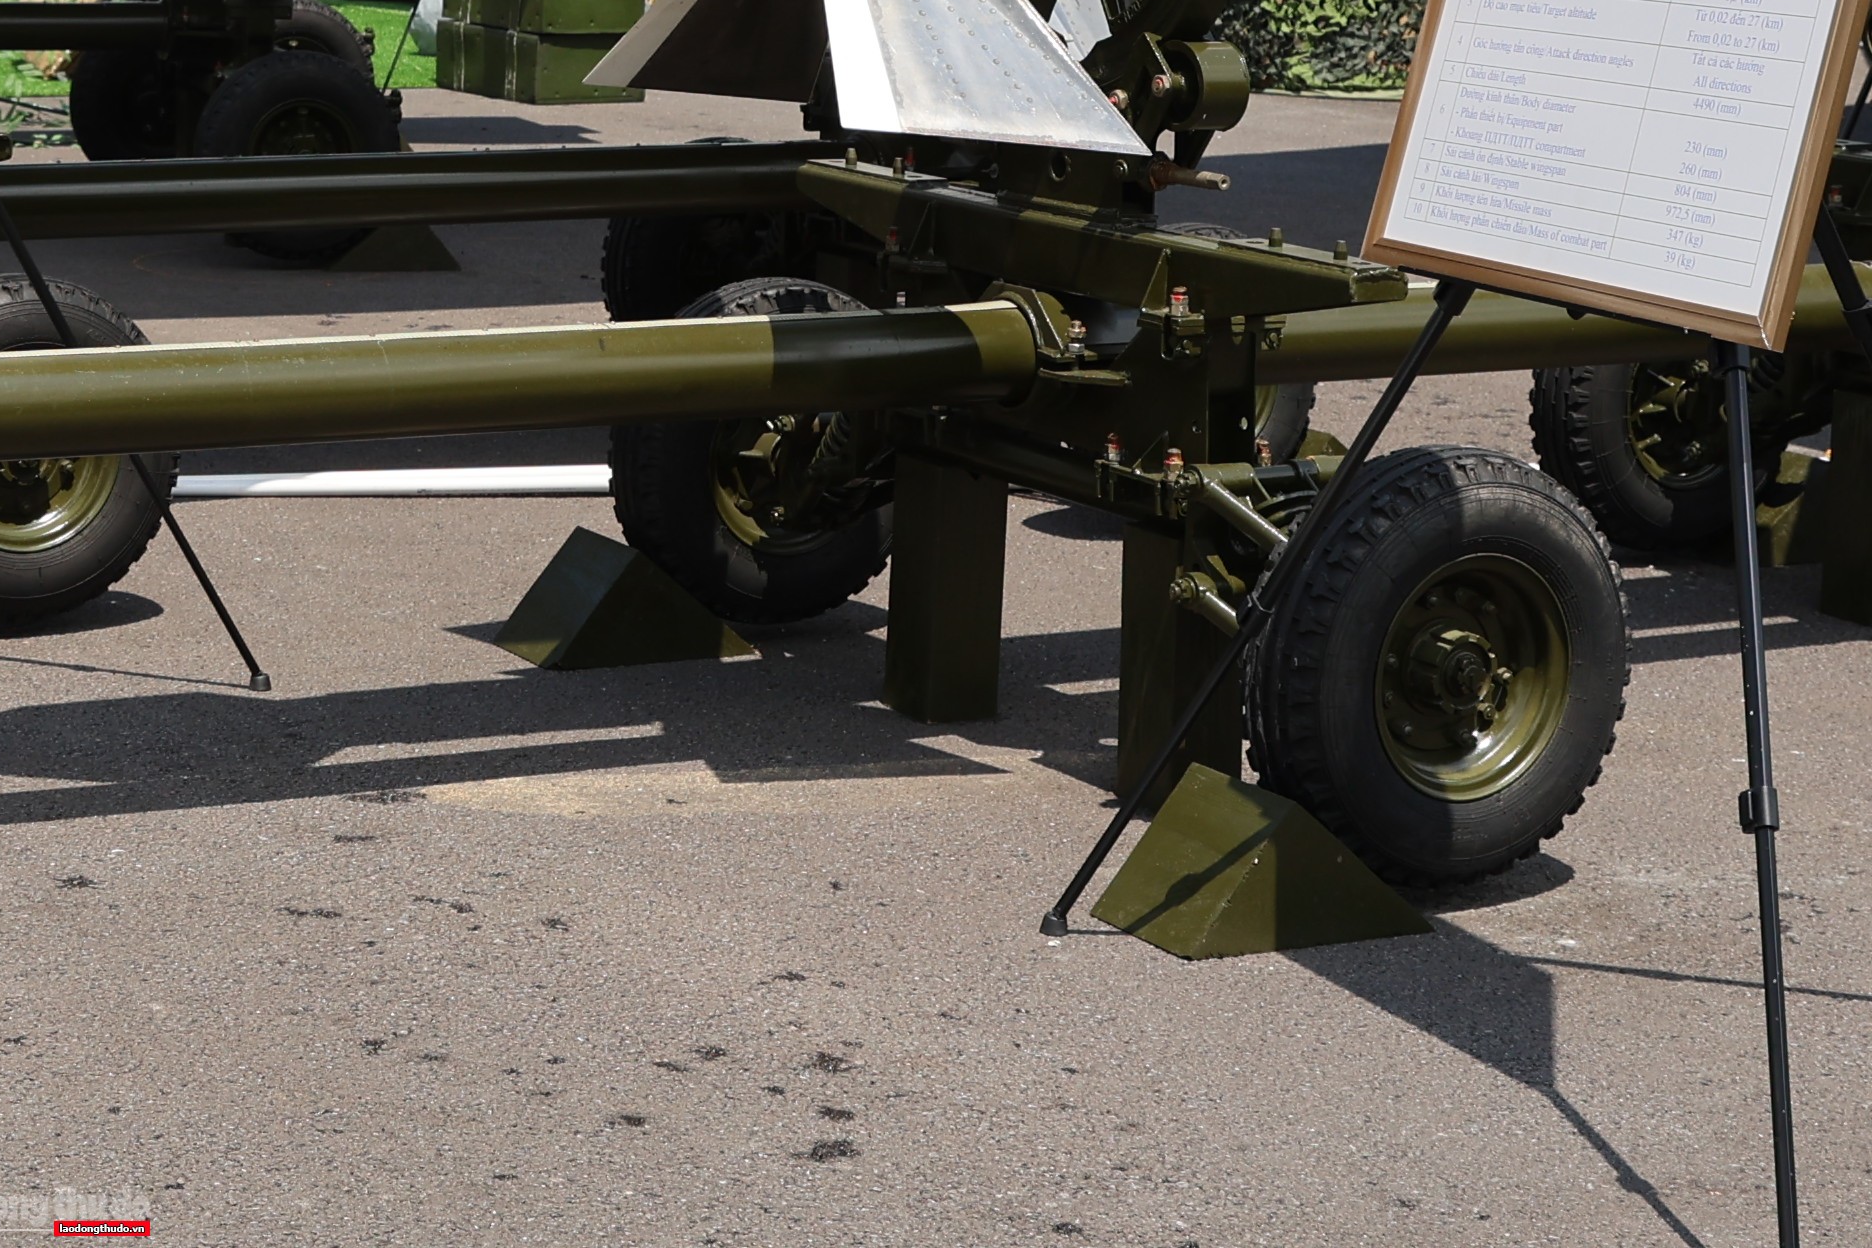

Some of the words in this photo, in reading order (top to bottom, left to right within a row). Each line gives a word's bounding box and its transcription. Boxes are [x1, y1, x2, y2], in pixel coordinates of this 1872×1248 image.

[1761, 16, 1783, 32] (km)
[1687, 30, 1711, 44] From
[1758, 38, 1780, 53] (km)
[1693, 76, 1708, 87] All
[1709, 77, 1752, 94] directions
[1693, 97, 1715, 110] 4490
[1666, 229, 1684, 242] 347
[1664, 251, 1676, 264] 39
